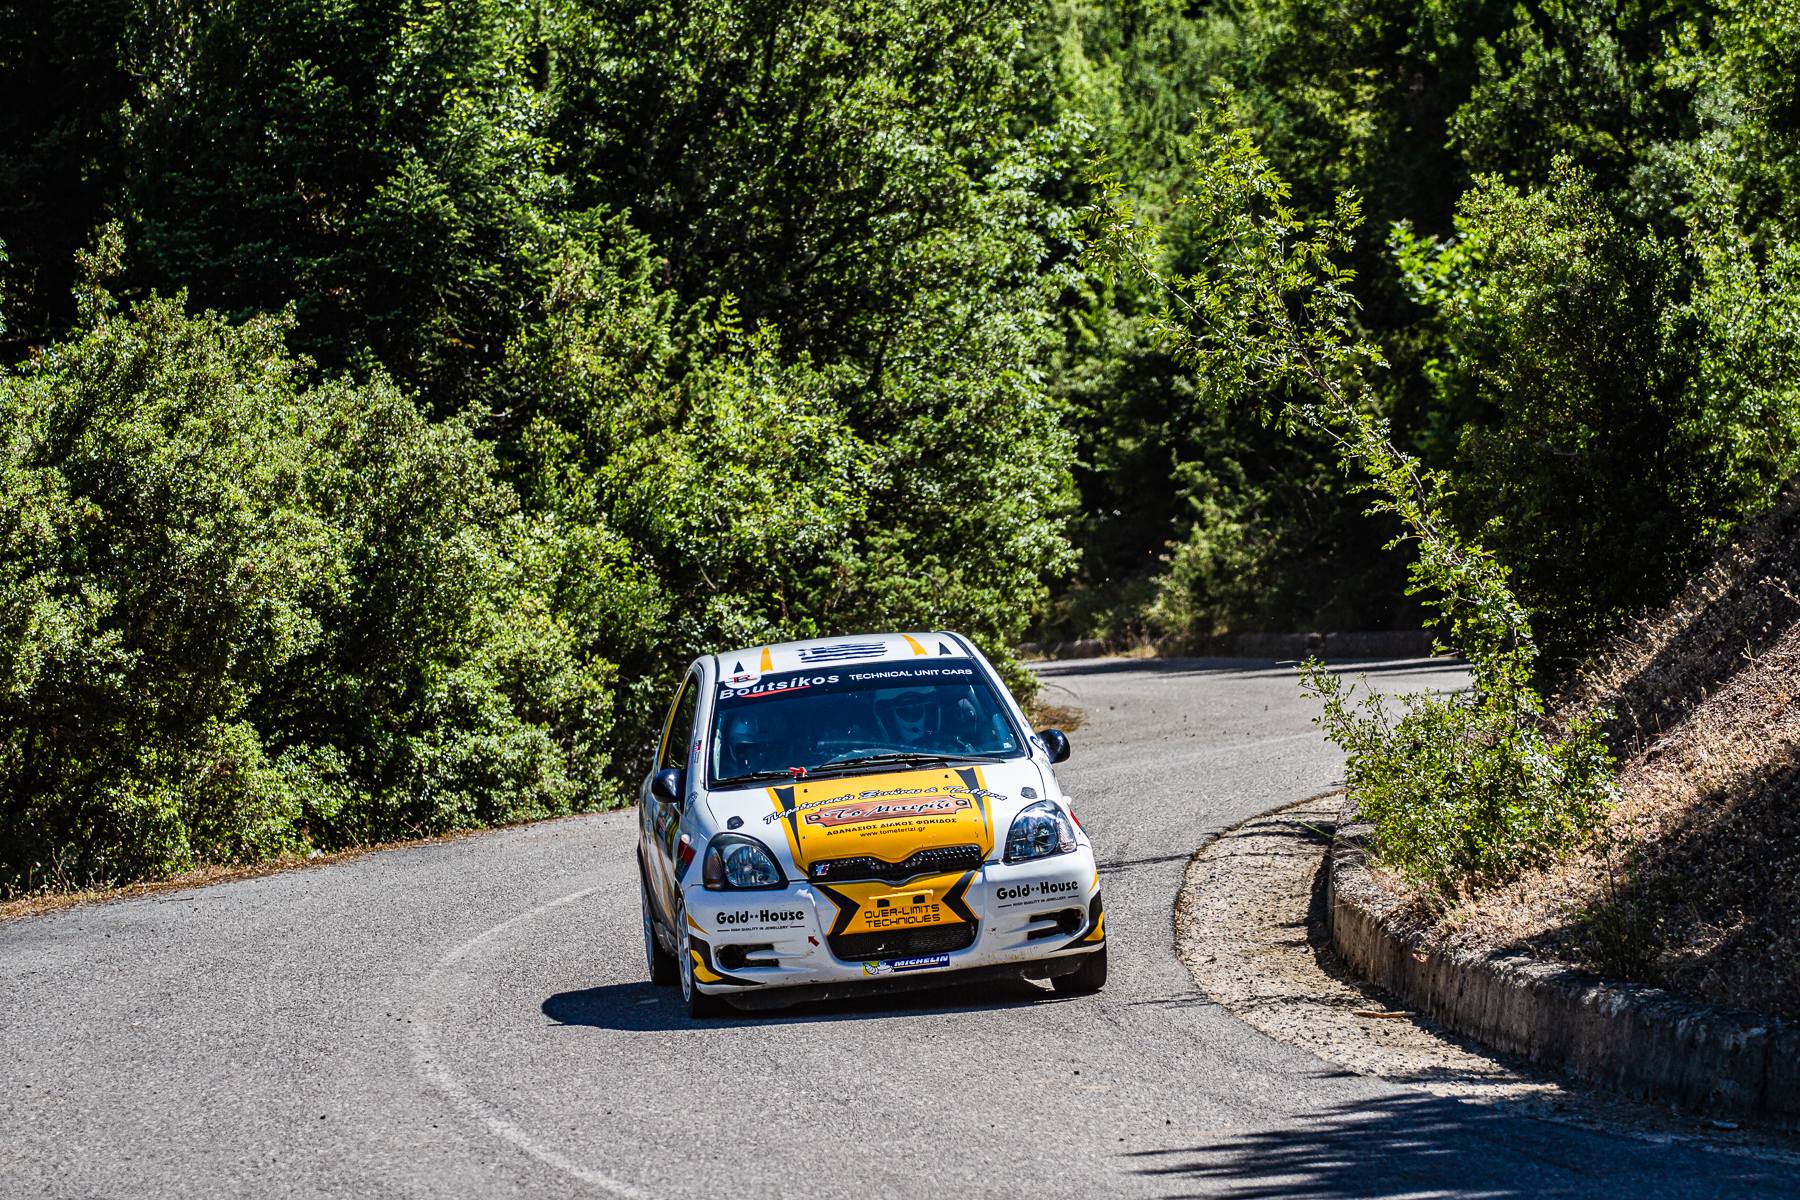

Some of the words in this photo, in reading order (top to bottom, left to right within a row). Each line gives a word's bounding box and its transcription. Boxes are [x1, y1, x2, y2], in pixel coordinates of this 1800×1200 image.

[849, 671, 912, 680] TECHNICAL
[827, 824, 877, 836] ΑΘΑΝΑΣΙΟΣ
[860, 826, 926, 837] www.tometerizi.gr
[865, 913, 941, 928] TECHNIQUES
[894, 956, 949, 967] MICHELIN
